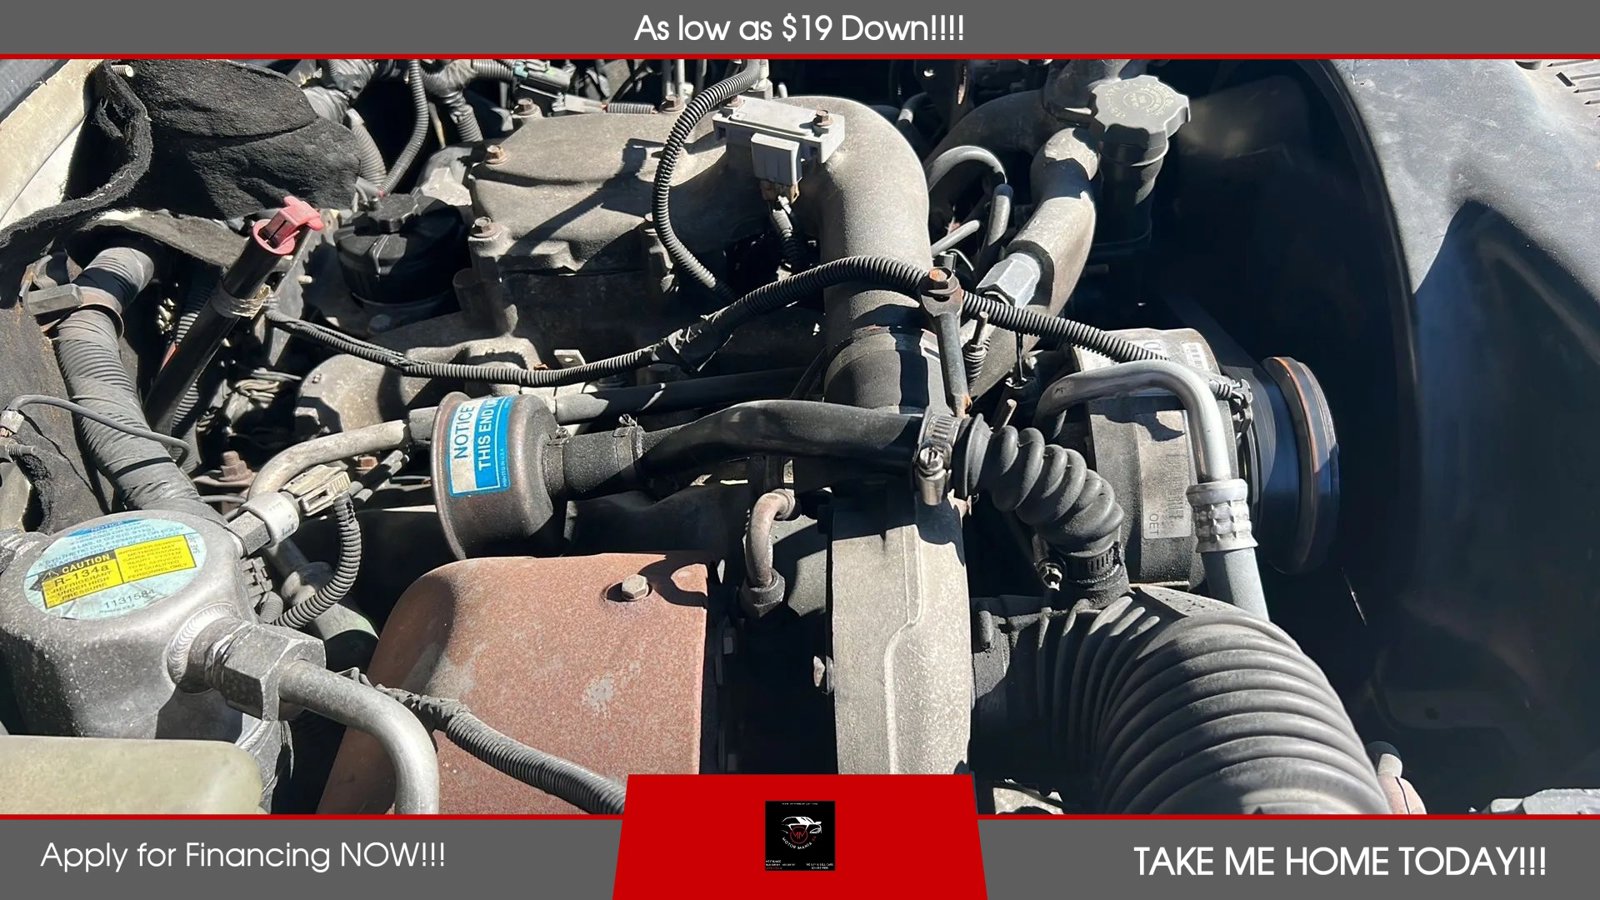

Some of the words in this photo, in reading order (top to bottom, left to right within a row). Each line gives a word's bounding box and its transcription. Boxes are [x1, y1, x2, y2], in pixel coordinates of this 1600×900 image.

[479, 409, 495, 432] END
[454, 406, 475, 460] NOTICE
[477, 435, 492, 471] THIS
[62, 554, 110, 574] CAUTION
[55, 565, 110, 587] R-134a
